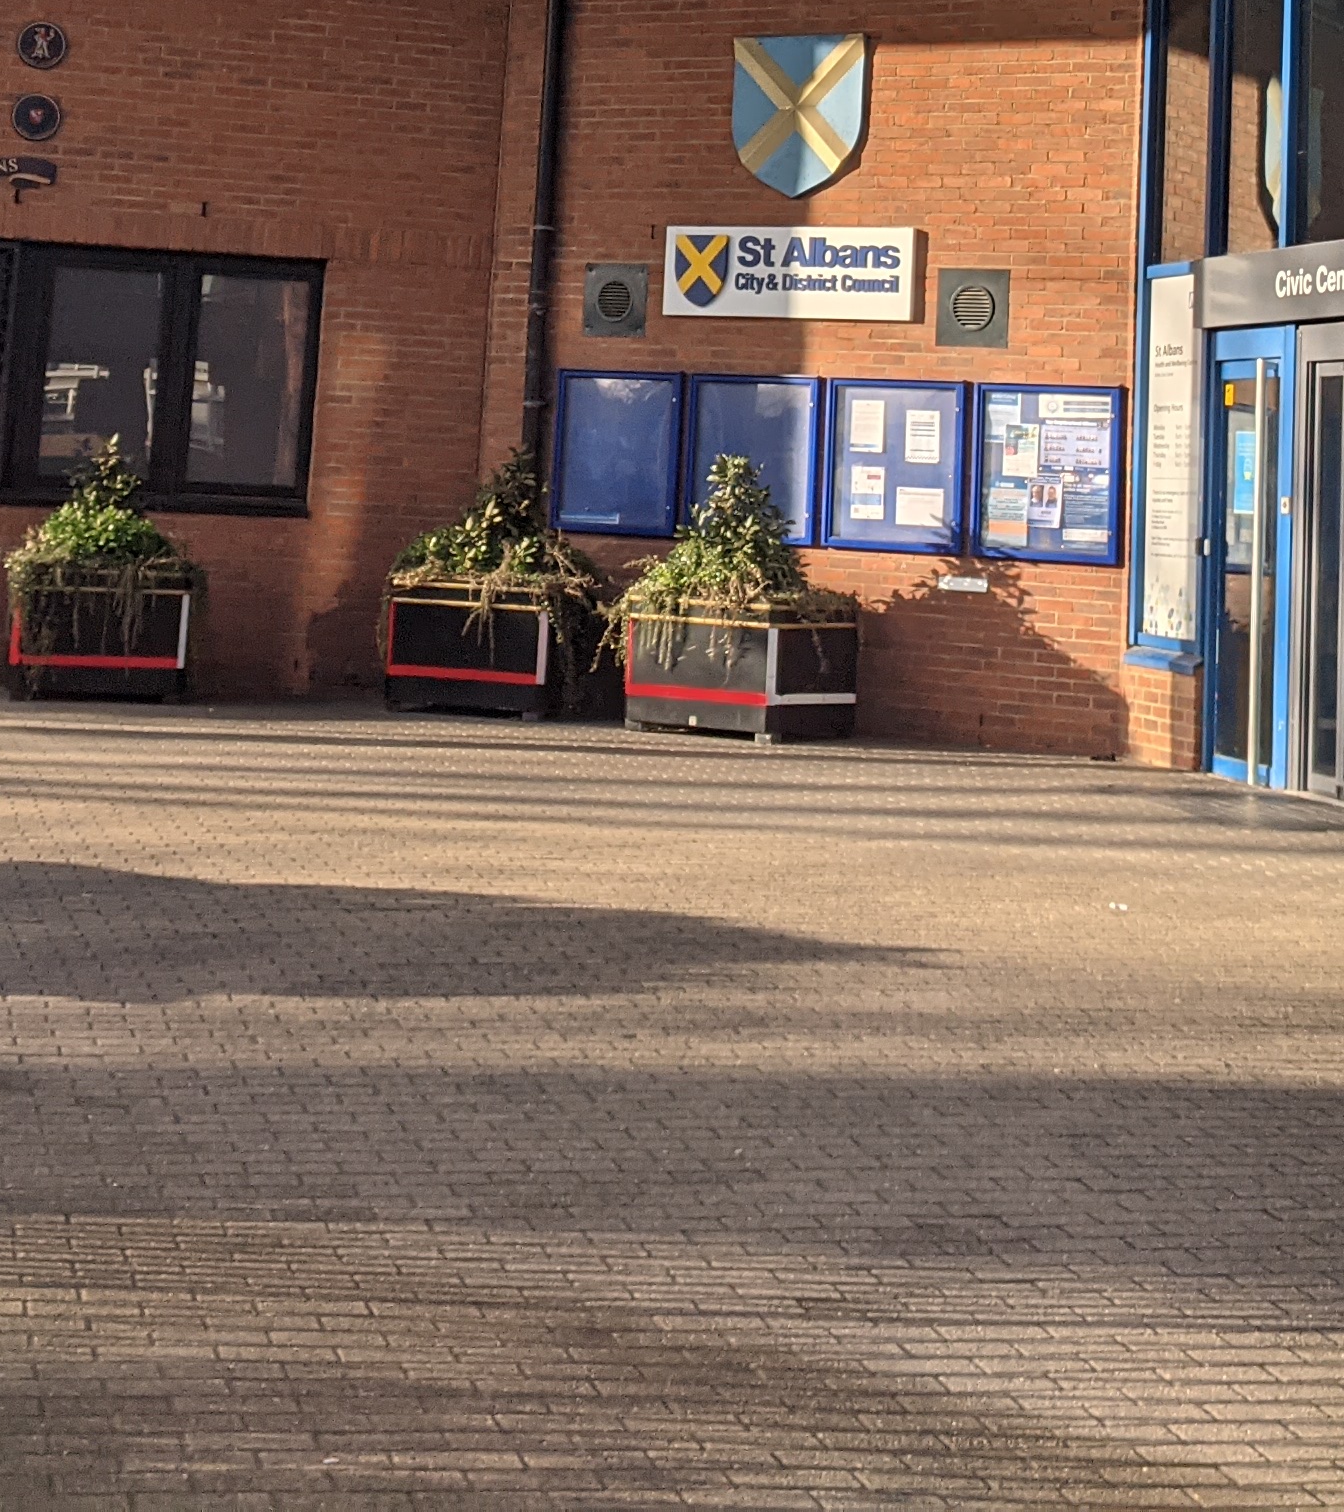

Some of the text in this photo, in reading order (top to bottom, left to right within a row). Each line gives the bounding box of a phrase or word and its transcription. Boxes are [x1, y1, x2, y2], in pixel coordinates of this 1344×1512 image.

[736, 235, 901, 269] St Albans
[734, 272, 900, 294] City & District Council
[1275, 267, 1313, 298] Civic
